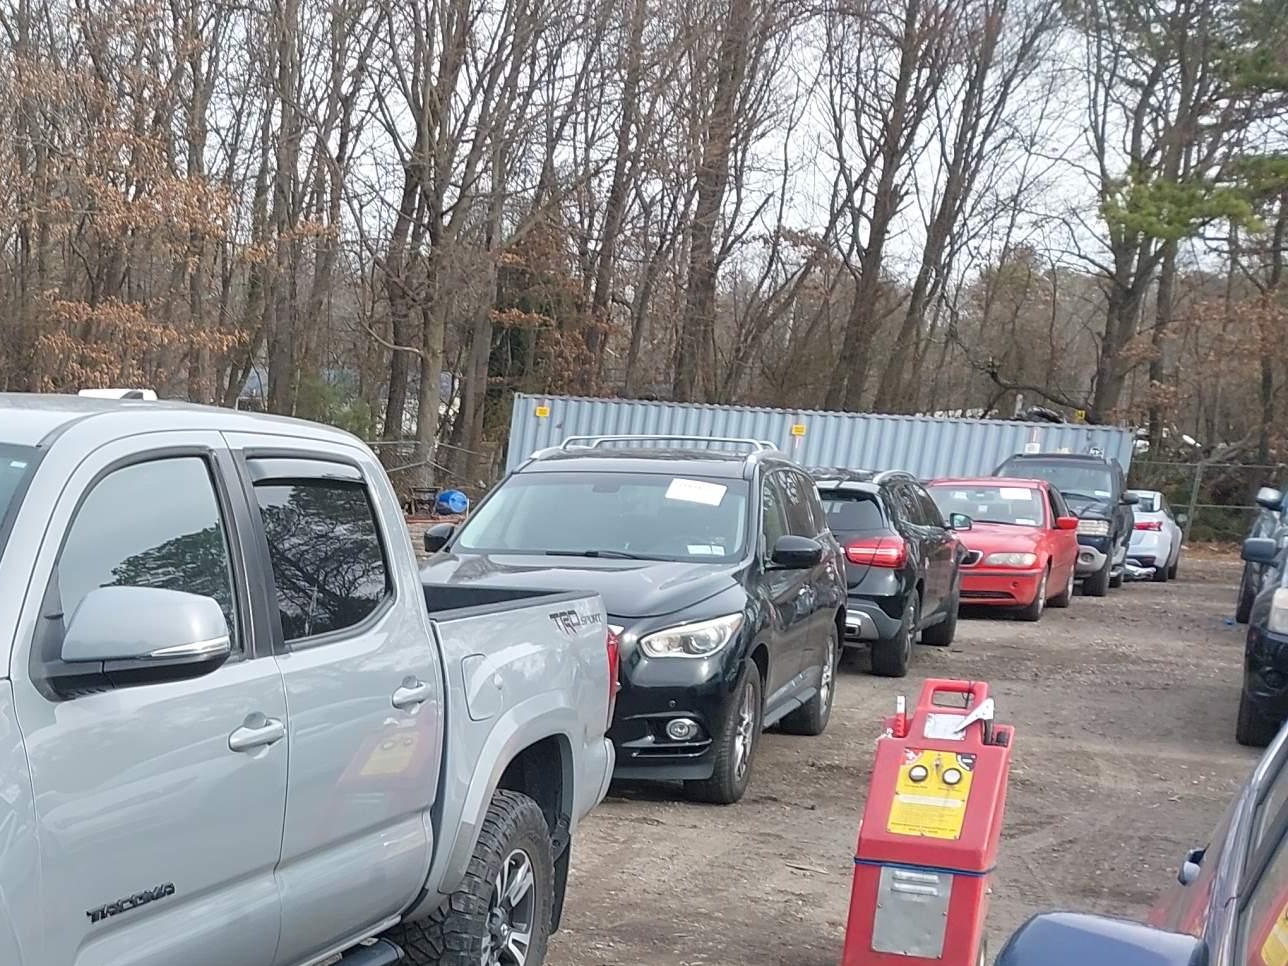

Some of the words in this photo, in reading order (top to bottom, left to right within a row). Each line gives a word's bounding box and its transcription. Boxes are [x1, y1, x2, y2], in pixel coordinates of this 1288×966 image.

[549, 609, 580, 636] TRD
[580, 613, 601, 626] SPORT
[86, 882, 176, 923] TACOMA
